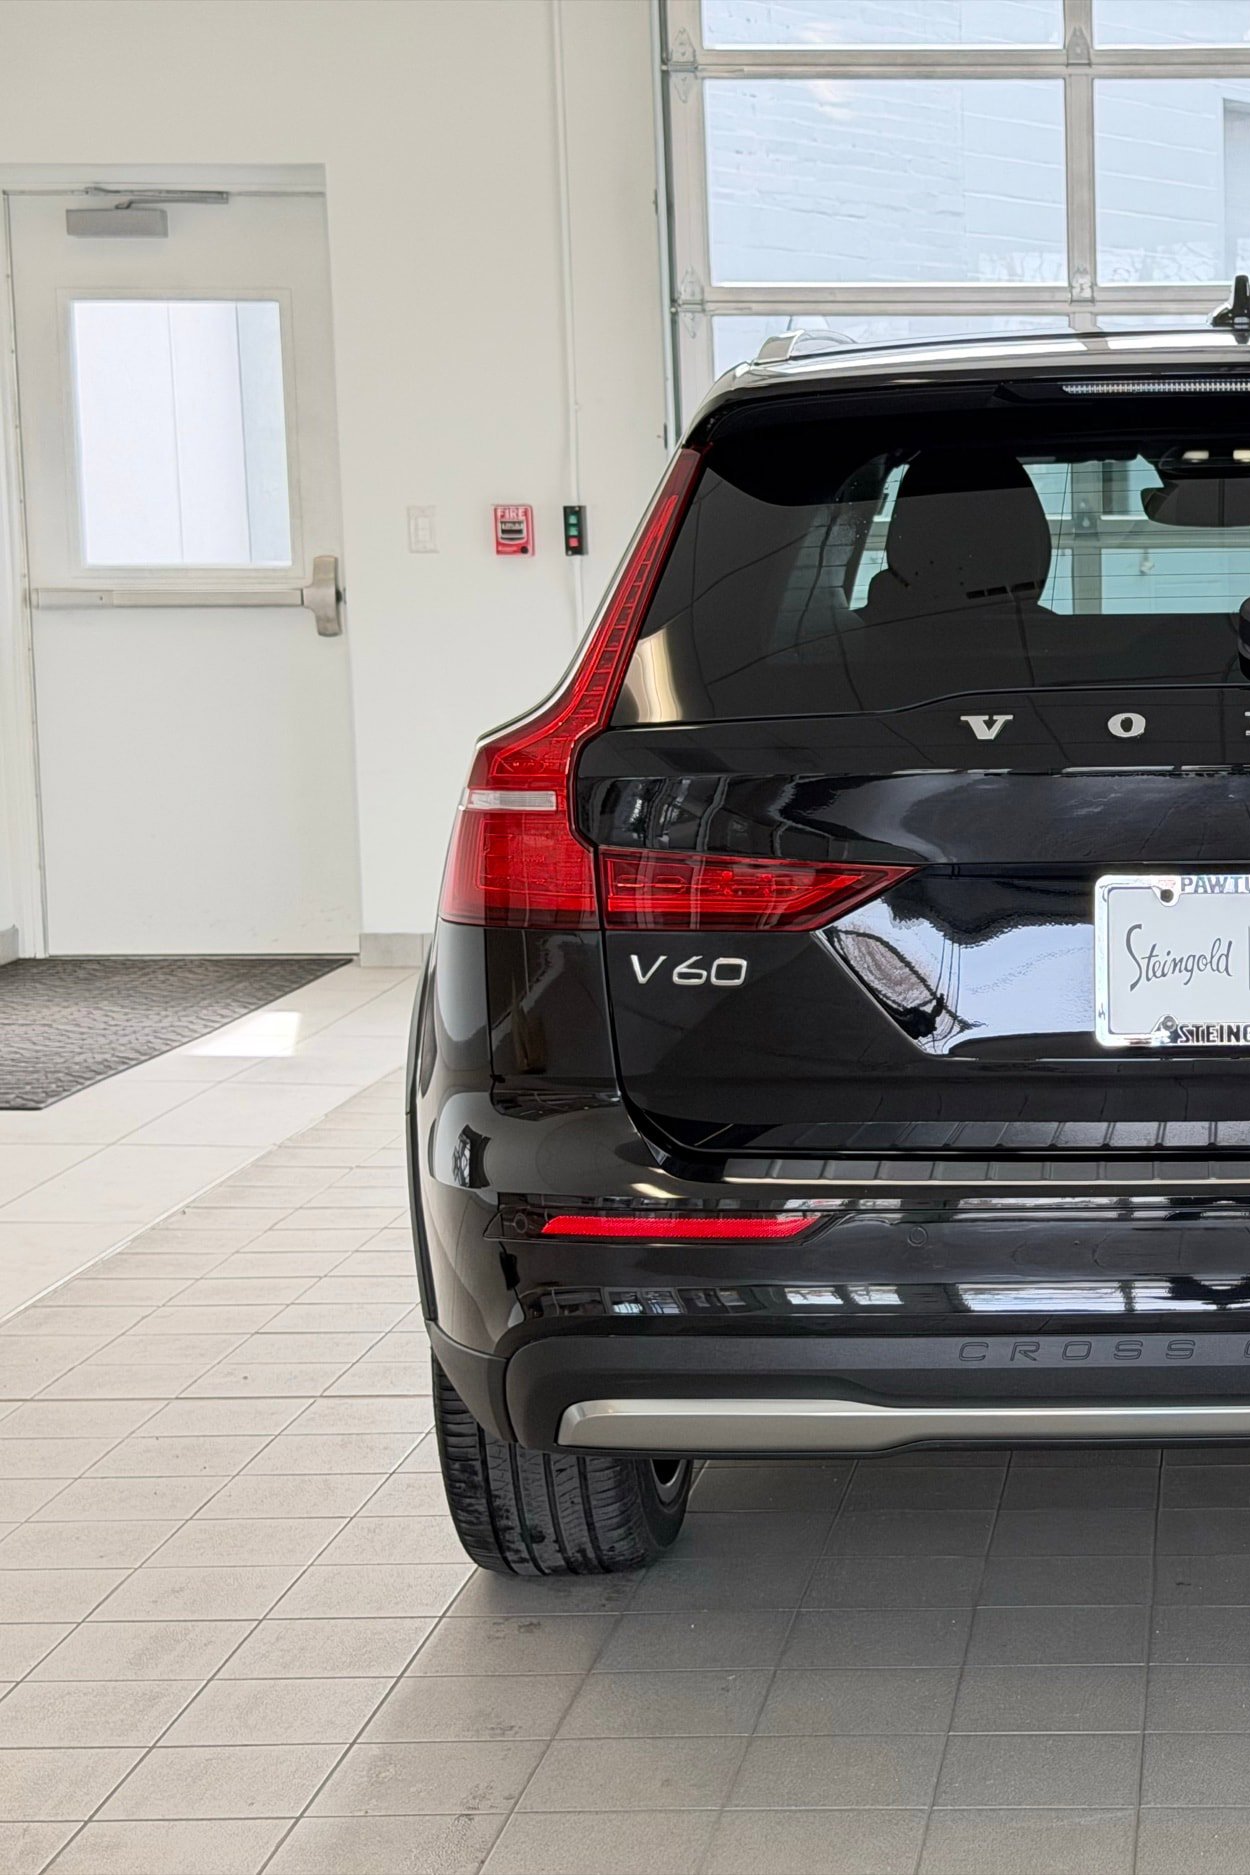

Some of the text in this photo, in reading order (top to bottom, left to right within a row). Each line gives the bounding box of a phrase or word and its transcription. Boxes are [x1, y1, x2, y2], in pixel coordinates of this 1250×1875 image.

[497, 507, 526, 519] FIRE
[630, 954, 748, 986] V60
[1126, 923, 1233, 992] Steingold
[958, 1339, 1197, 1362] CROSS
